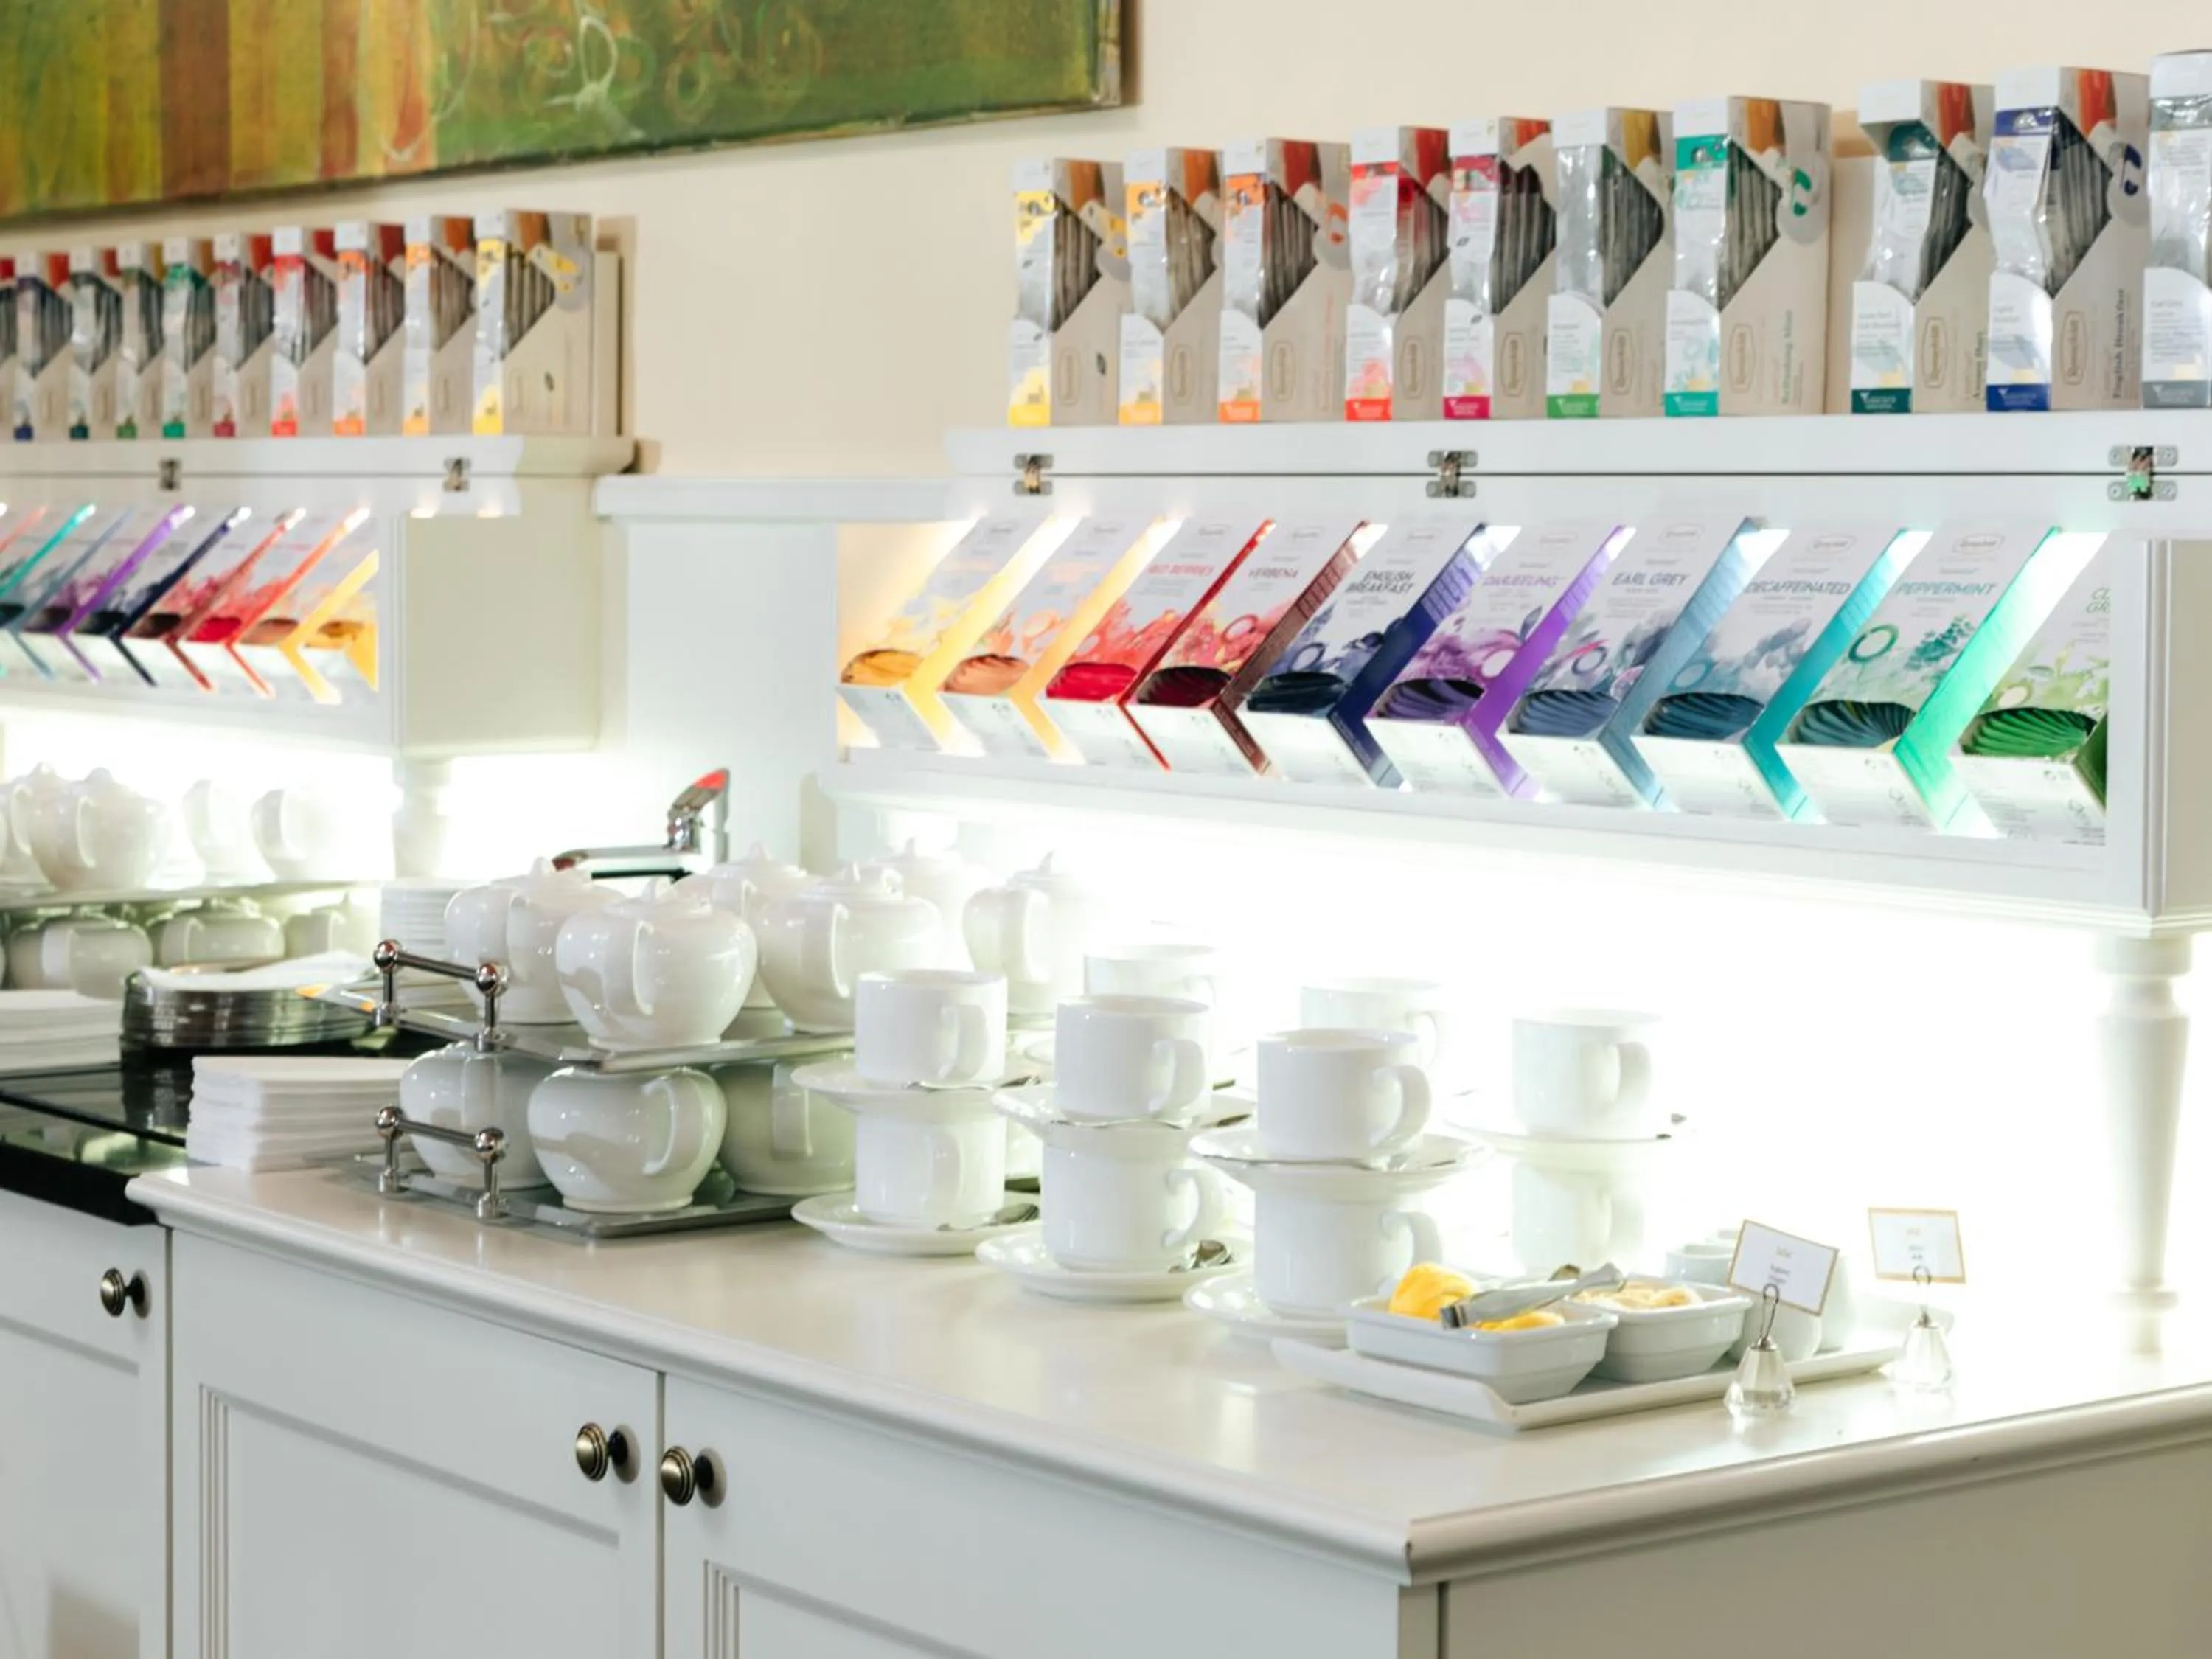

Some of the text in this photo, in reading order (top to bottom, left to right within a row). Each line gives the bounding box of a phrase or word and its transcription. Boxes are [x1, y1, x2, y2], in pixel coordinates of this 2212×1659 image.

[1362, 570, 1416, 582] ENGLISH
[1611, 571, 1692, 588] EARL GREY
[1344, 581, 1416, 595] BREAKFAST
[1895, 580, 1998, 596] PEPPERMINT
